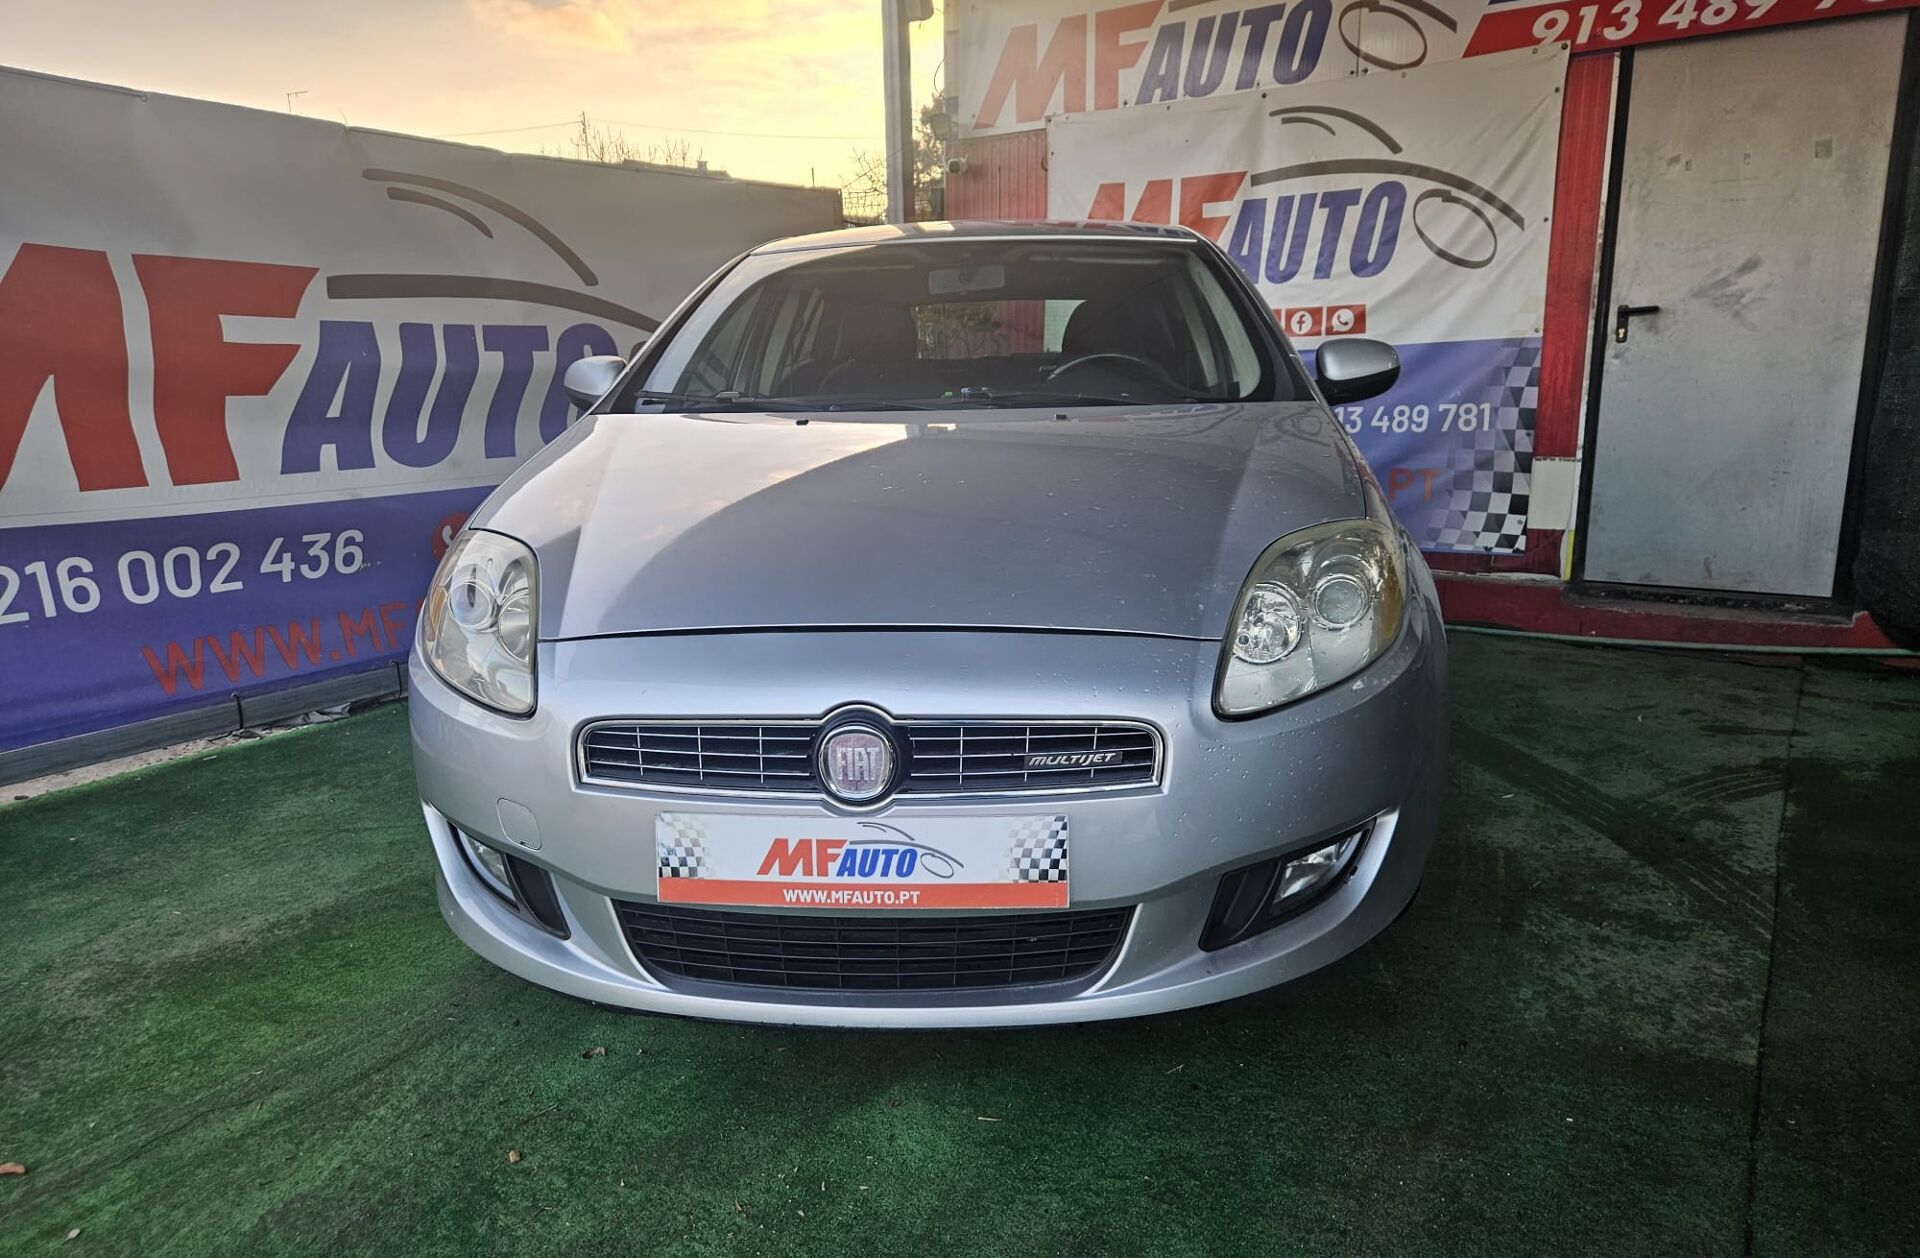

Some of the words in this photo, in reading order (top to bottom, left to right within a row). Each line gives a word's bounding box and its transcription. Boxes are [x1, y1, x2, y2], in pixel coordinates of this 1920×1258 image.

[1532, 0, 1642, 46] 913
[1370, 404, 1430, 433] 489
[1438, 402, 1491, 432] 781
[0, 556, 101, 625] 216
[117, 542, 244, 605] 002
[260, 529, 365, 583] 436
[141, 597, 427, 696] WWW.MF
[836, 747, 880, 781] FIAT
[1028, 752, 1117, 767] MULTIJET
[782, 888, 921, 905] WWW.MFAUTO.PT
